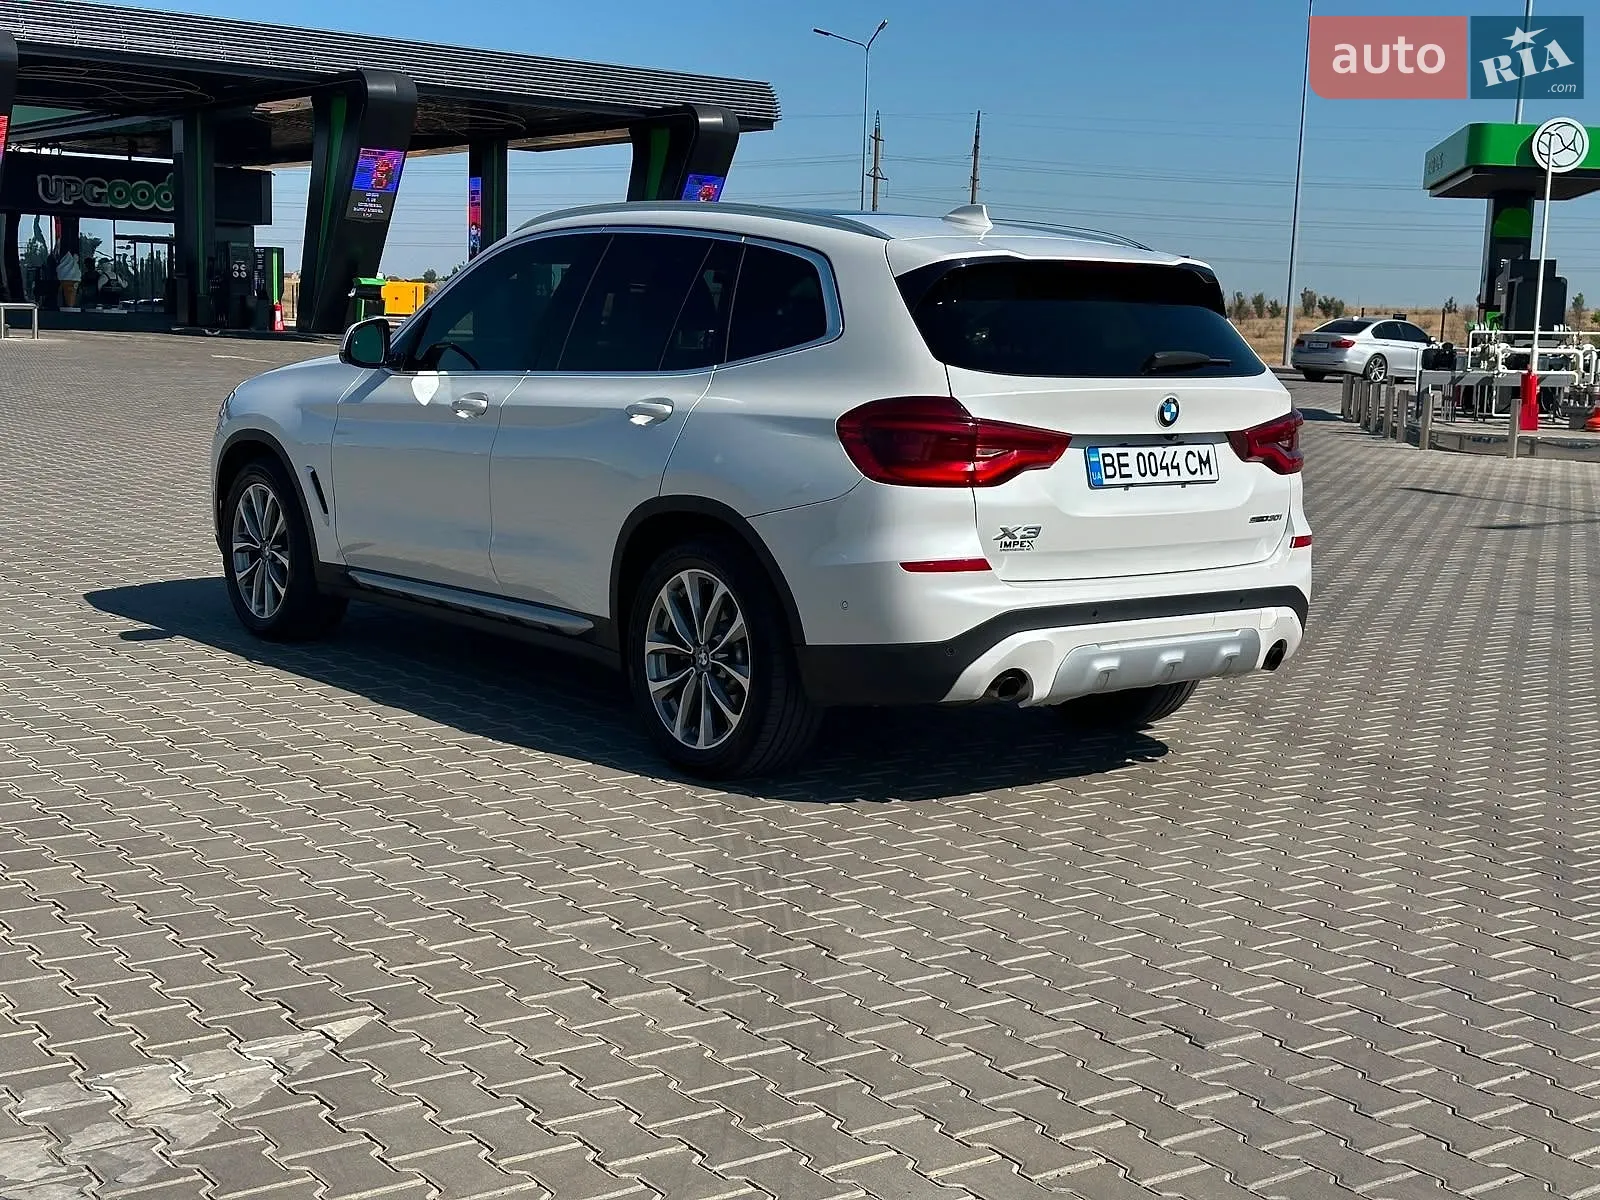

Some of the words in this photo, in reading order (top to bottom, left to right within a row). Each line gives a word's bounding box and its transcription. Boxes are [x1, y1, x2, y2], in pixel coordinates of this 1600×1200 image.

[1101, 452, 1133, 479] BE
[1136, 450, 1181, 478] 0044
[1184, 449, 1213, 475] CM
[1092, 471, 1102, 481] UA
[992, 526, 1041, 540] X3
[999, 540, 1034, 549] IMPEX
